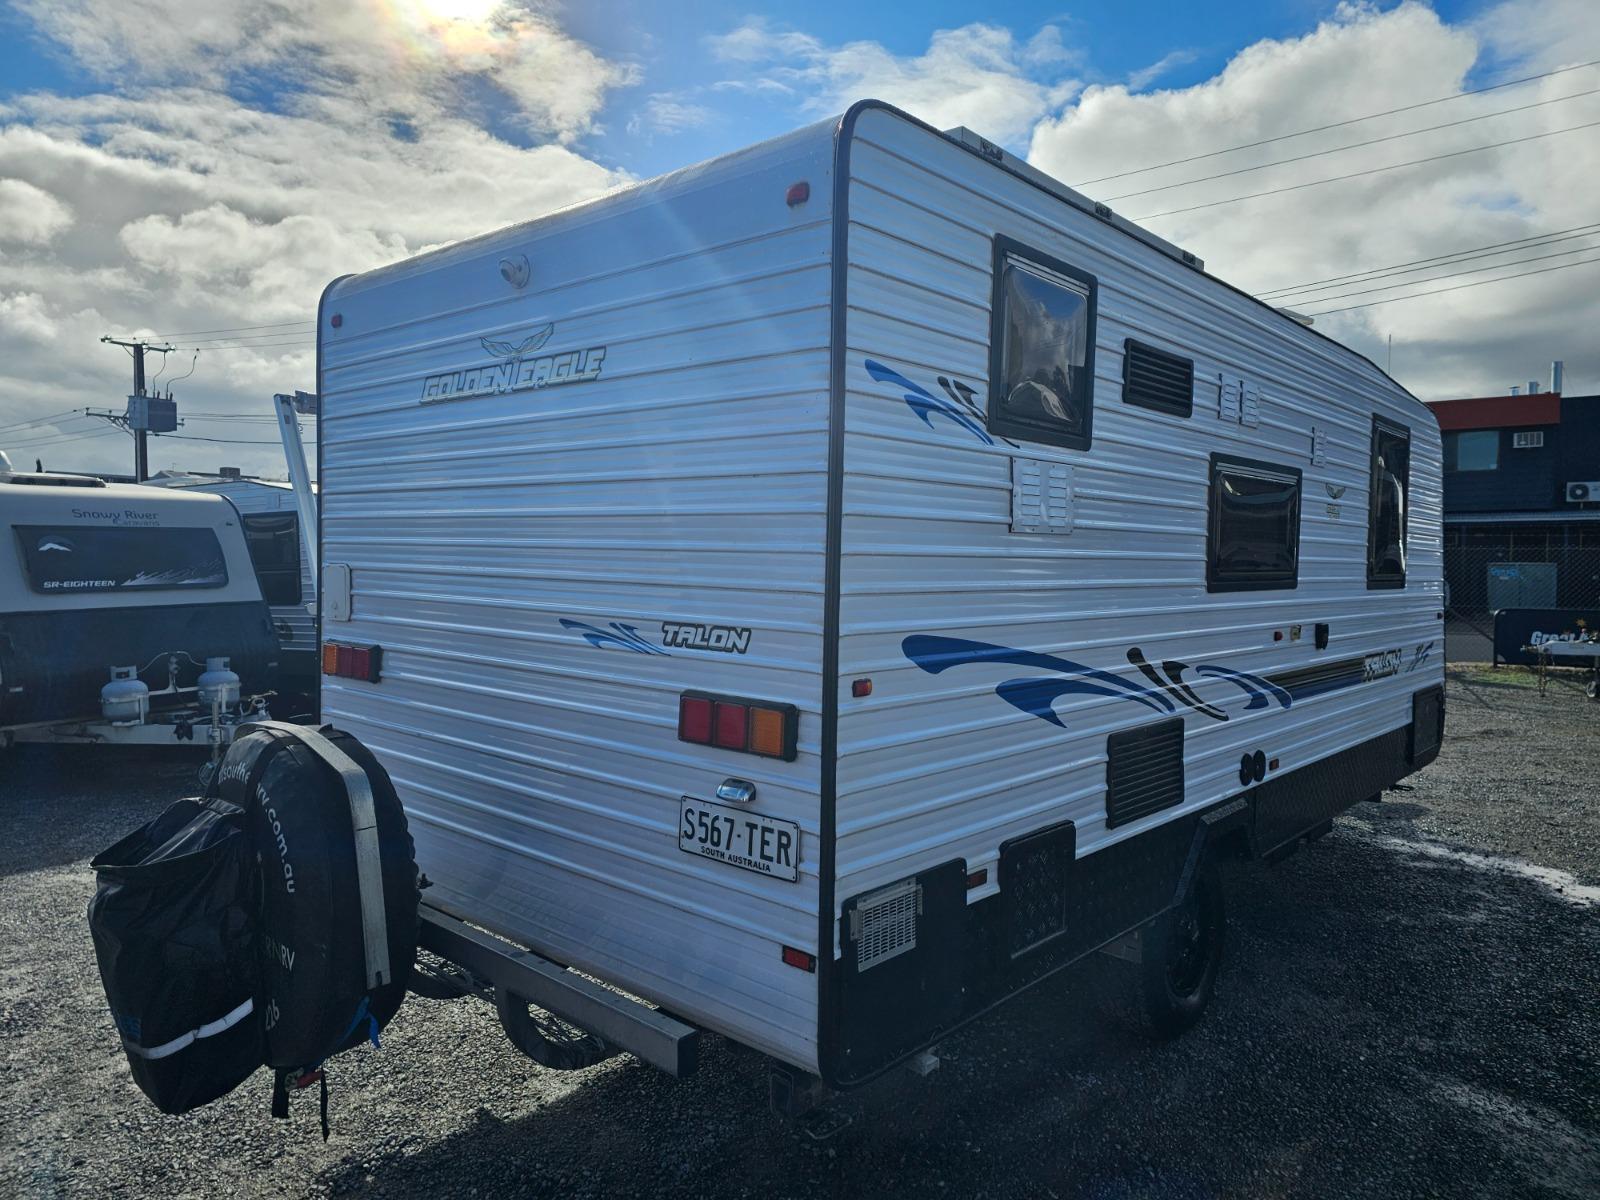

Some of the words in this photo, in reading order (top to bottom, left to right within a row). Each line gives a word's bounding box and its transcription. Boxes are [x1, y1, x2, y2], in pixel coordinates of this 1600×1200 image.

[71, 508, 121, 523] Snowy
[124, 510, 159, 520] River
[43, 580, 116, 588] SR-EIGHTEEN
[662, 621, 751, 655] TALON
[701, 845, 726, 861] SOUTH
[727, 854, 771, 873] AUSTRALIA
